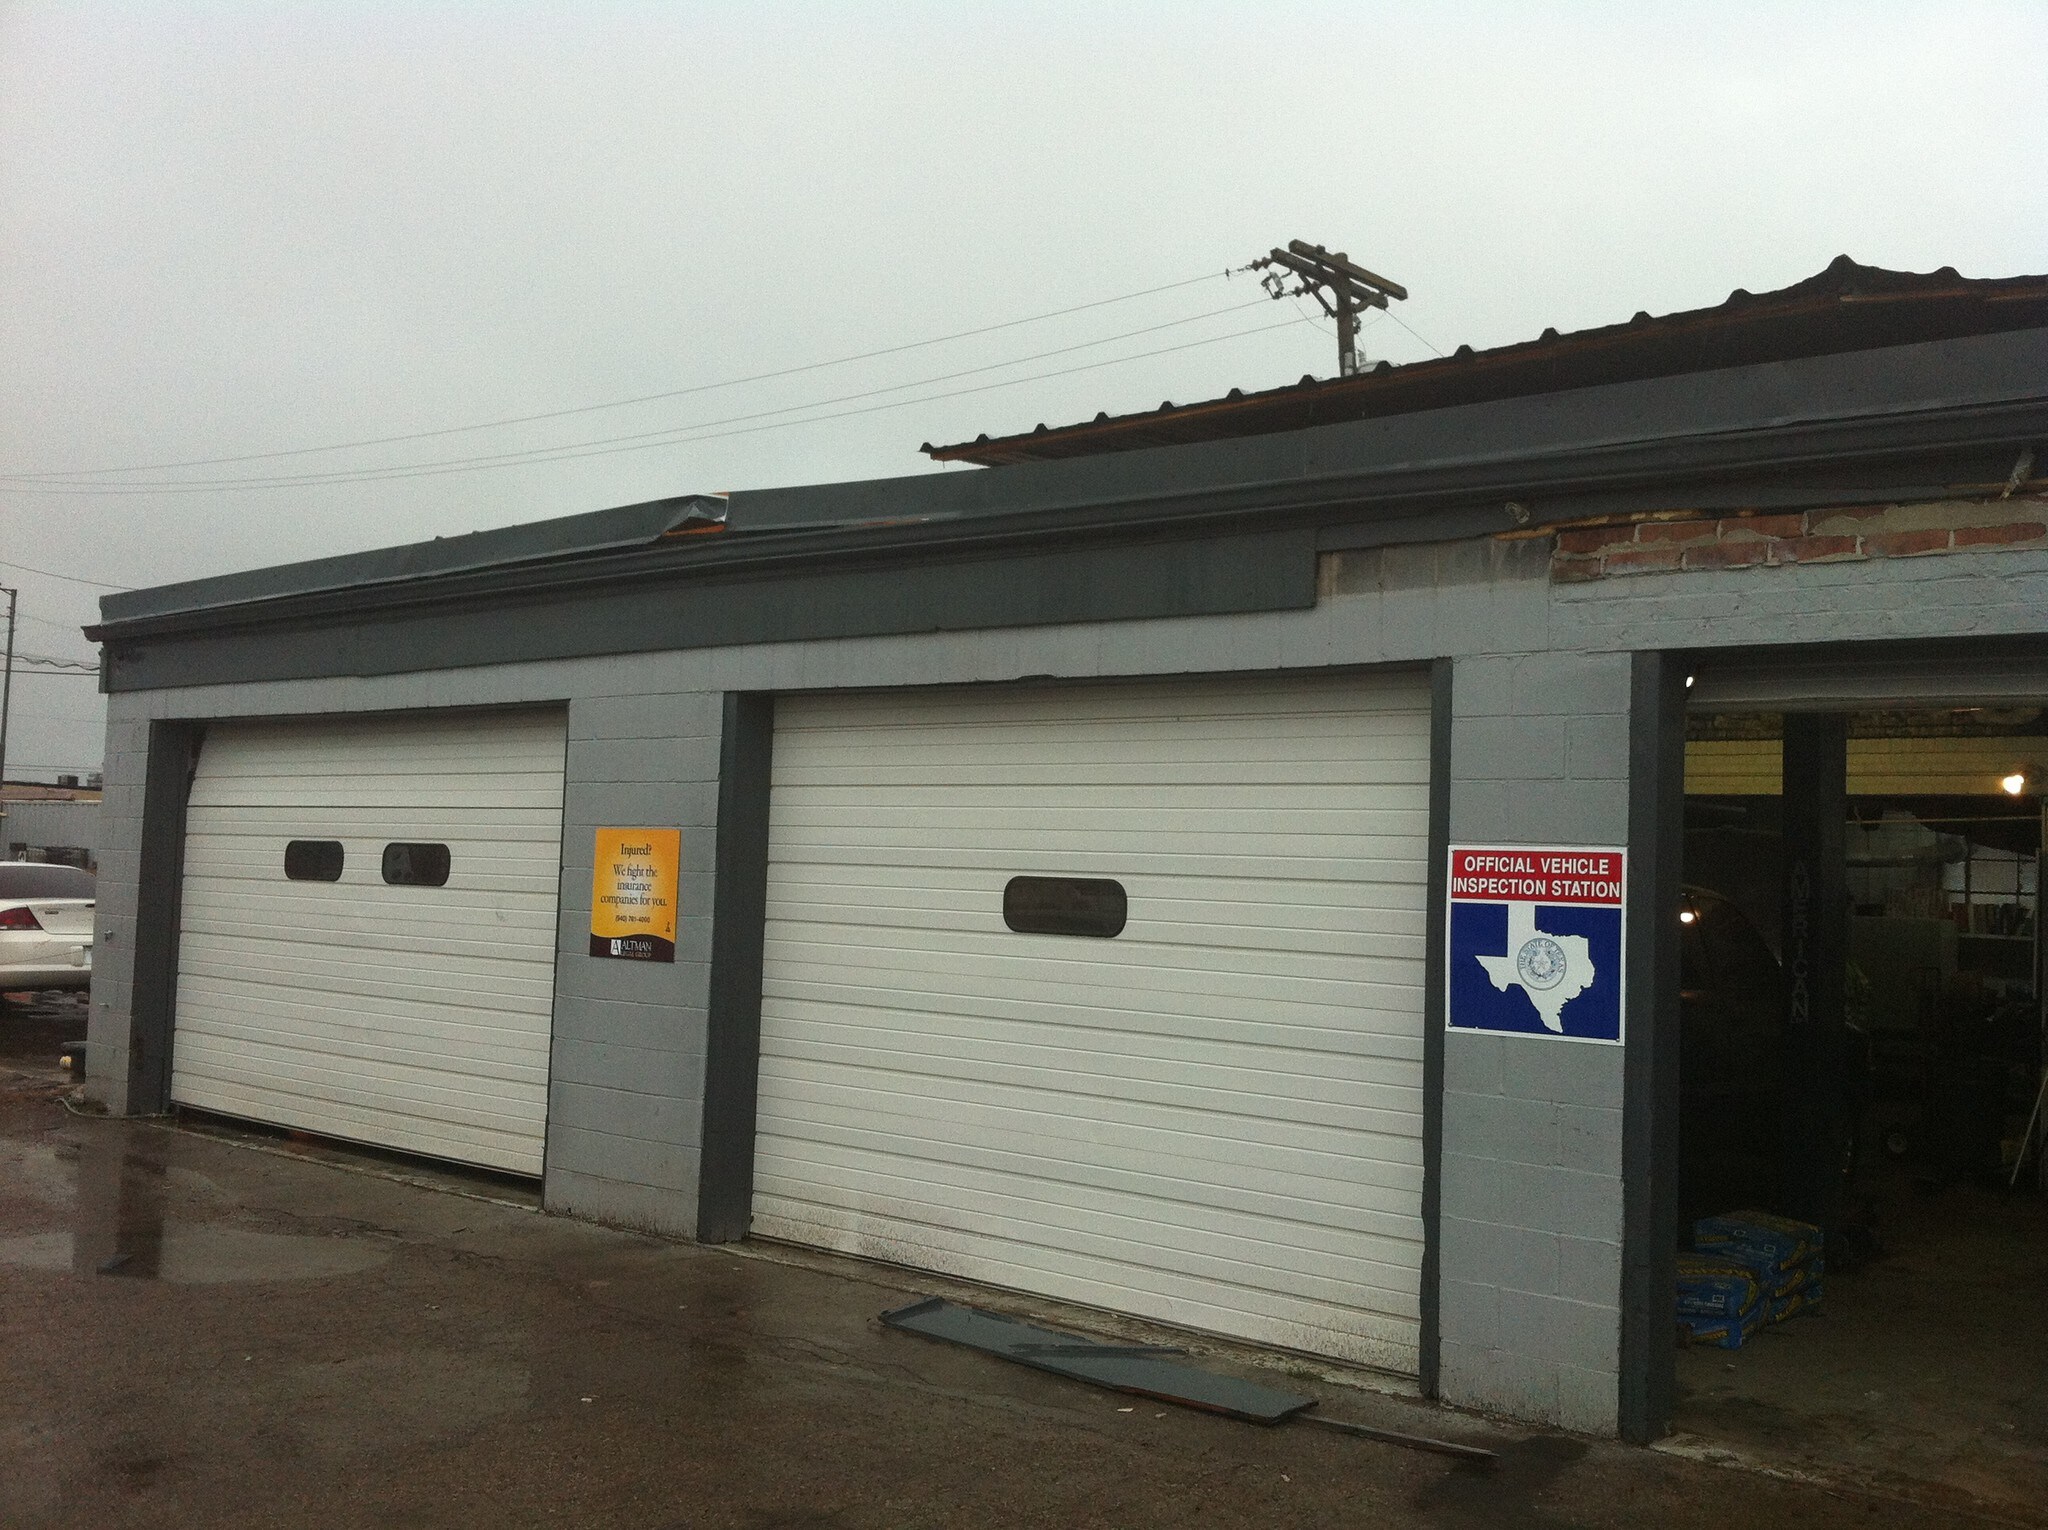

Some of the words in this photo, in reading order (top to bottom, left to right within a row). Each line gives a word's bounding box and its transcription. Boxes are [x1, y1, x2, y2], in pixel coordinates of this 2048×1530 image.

[620, 843, 652, 858] Injured?
[613, 864, 626, 877] We
[626, 863, 644, 881] fight
[646, 865, 658, 878] the
[1464, 856, 1535, 873] OFFICIAL
[1541, 858, 1609, 875] VEHICLE
[616, 880, 651, 891] insurance
[1453, 877, 1546, 896] INSPECTION
[1551, 880, 1620, 898] STATION
[600, 895, 638, 908] companies
[639, 893, 650, 907] for
[622, 939, 652, 952] ALTMAN
